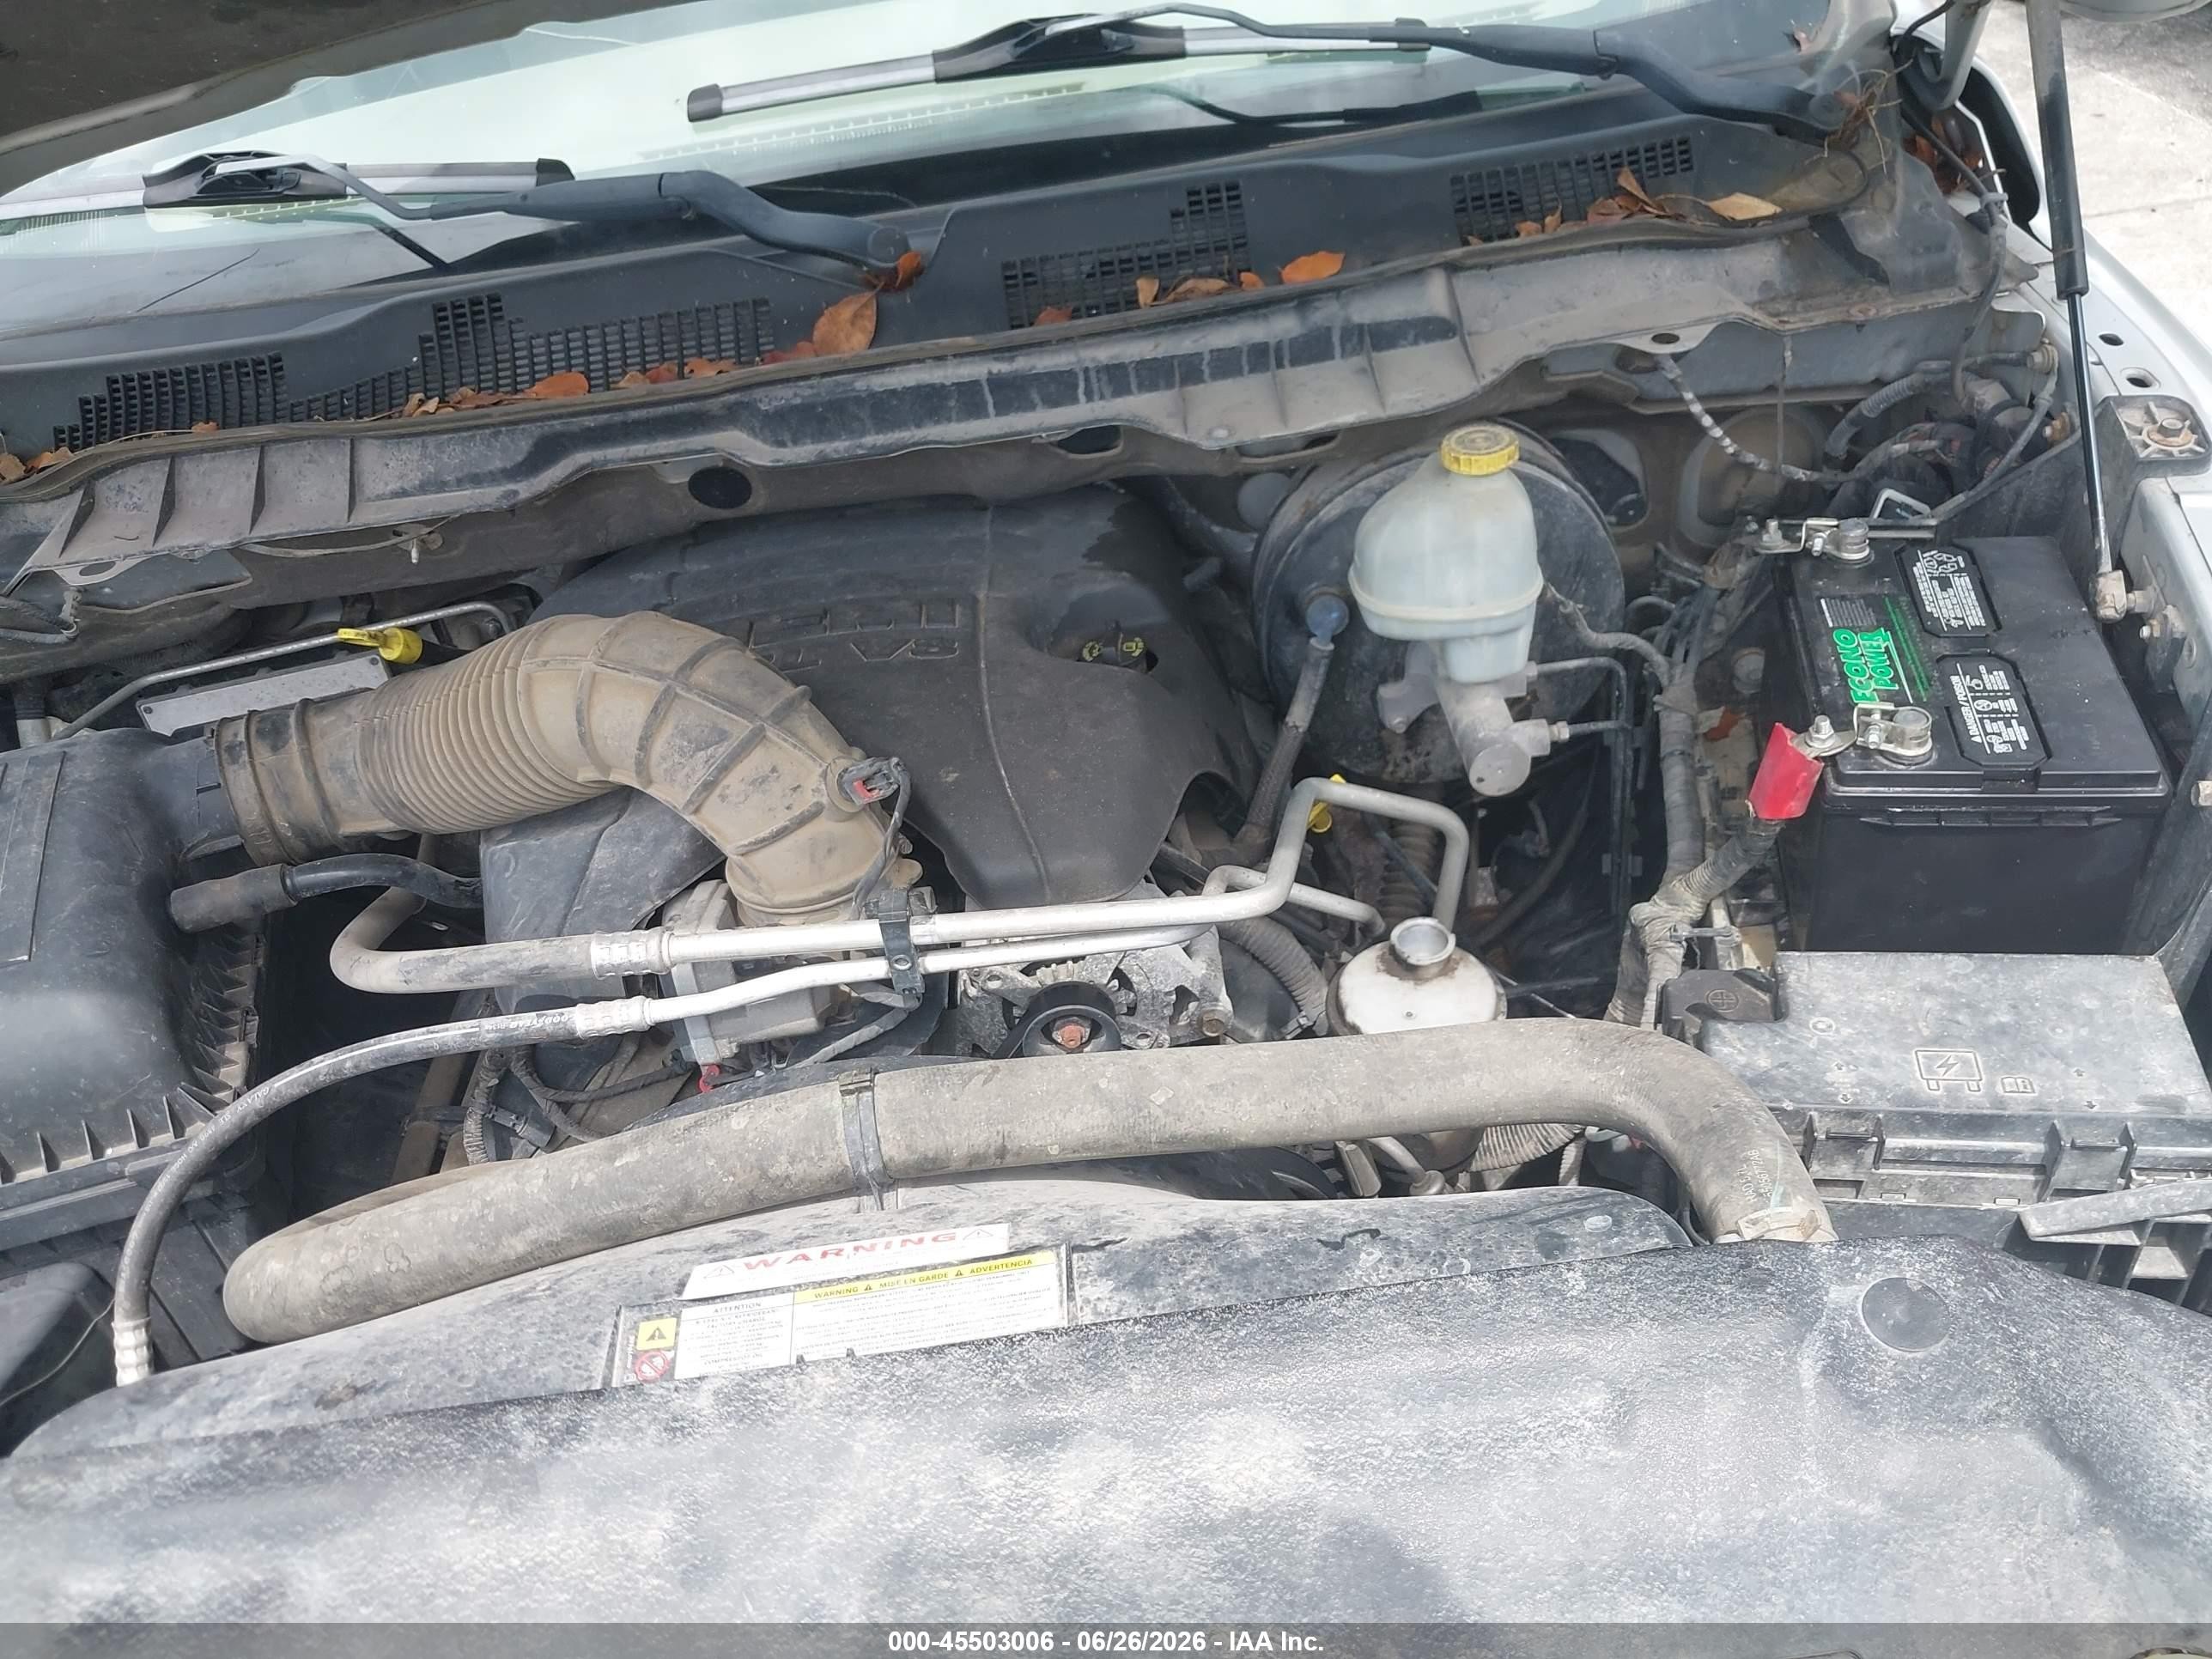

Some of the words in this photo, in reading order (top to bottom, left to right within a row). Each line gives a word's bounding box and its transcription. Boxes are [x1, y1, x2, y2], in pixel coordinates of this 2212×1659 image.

[1832, 628, 1879, 703] ECONO
[1857, 627, 1899, 690] POWER
[1961, 706, 1978, 736] DANGER
[743, 1231, 957, 1270] WARNING
[814, 1286, 859, 1299] WARNING
[918, 1272, 949, 1283] GARDE
[969, 1259, 1033, 1275] ADVERTENCIA
[714, 1302, 762, 1314] ATTENTION
